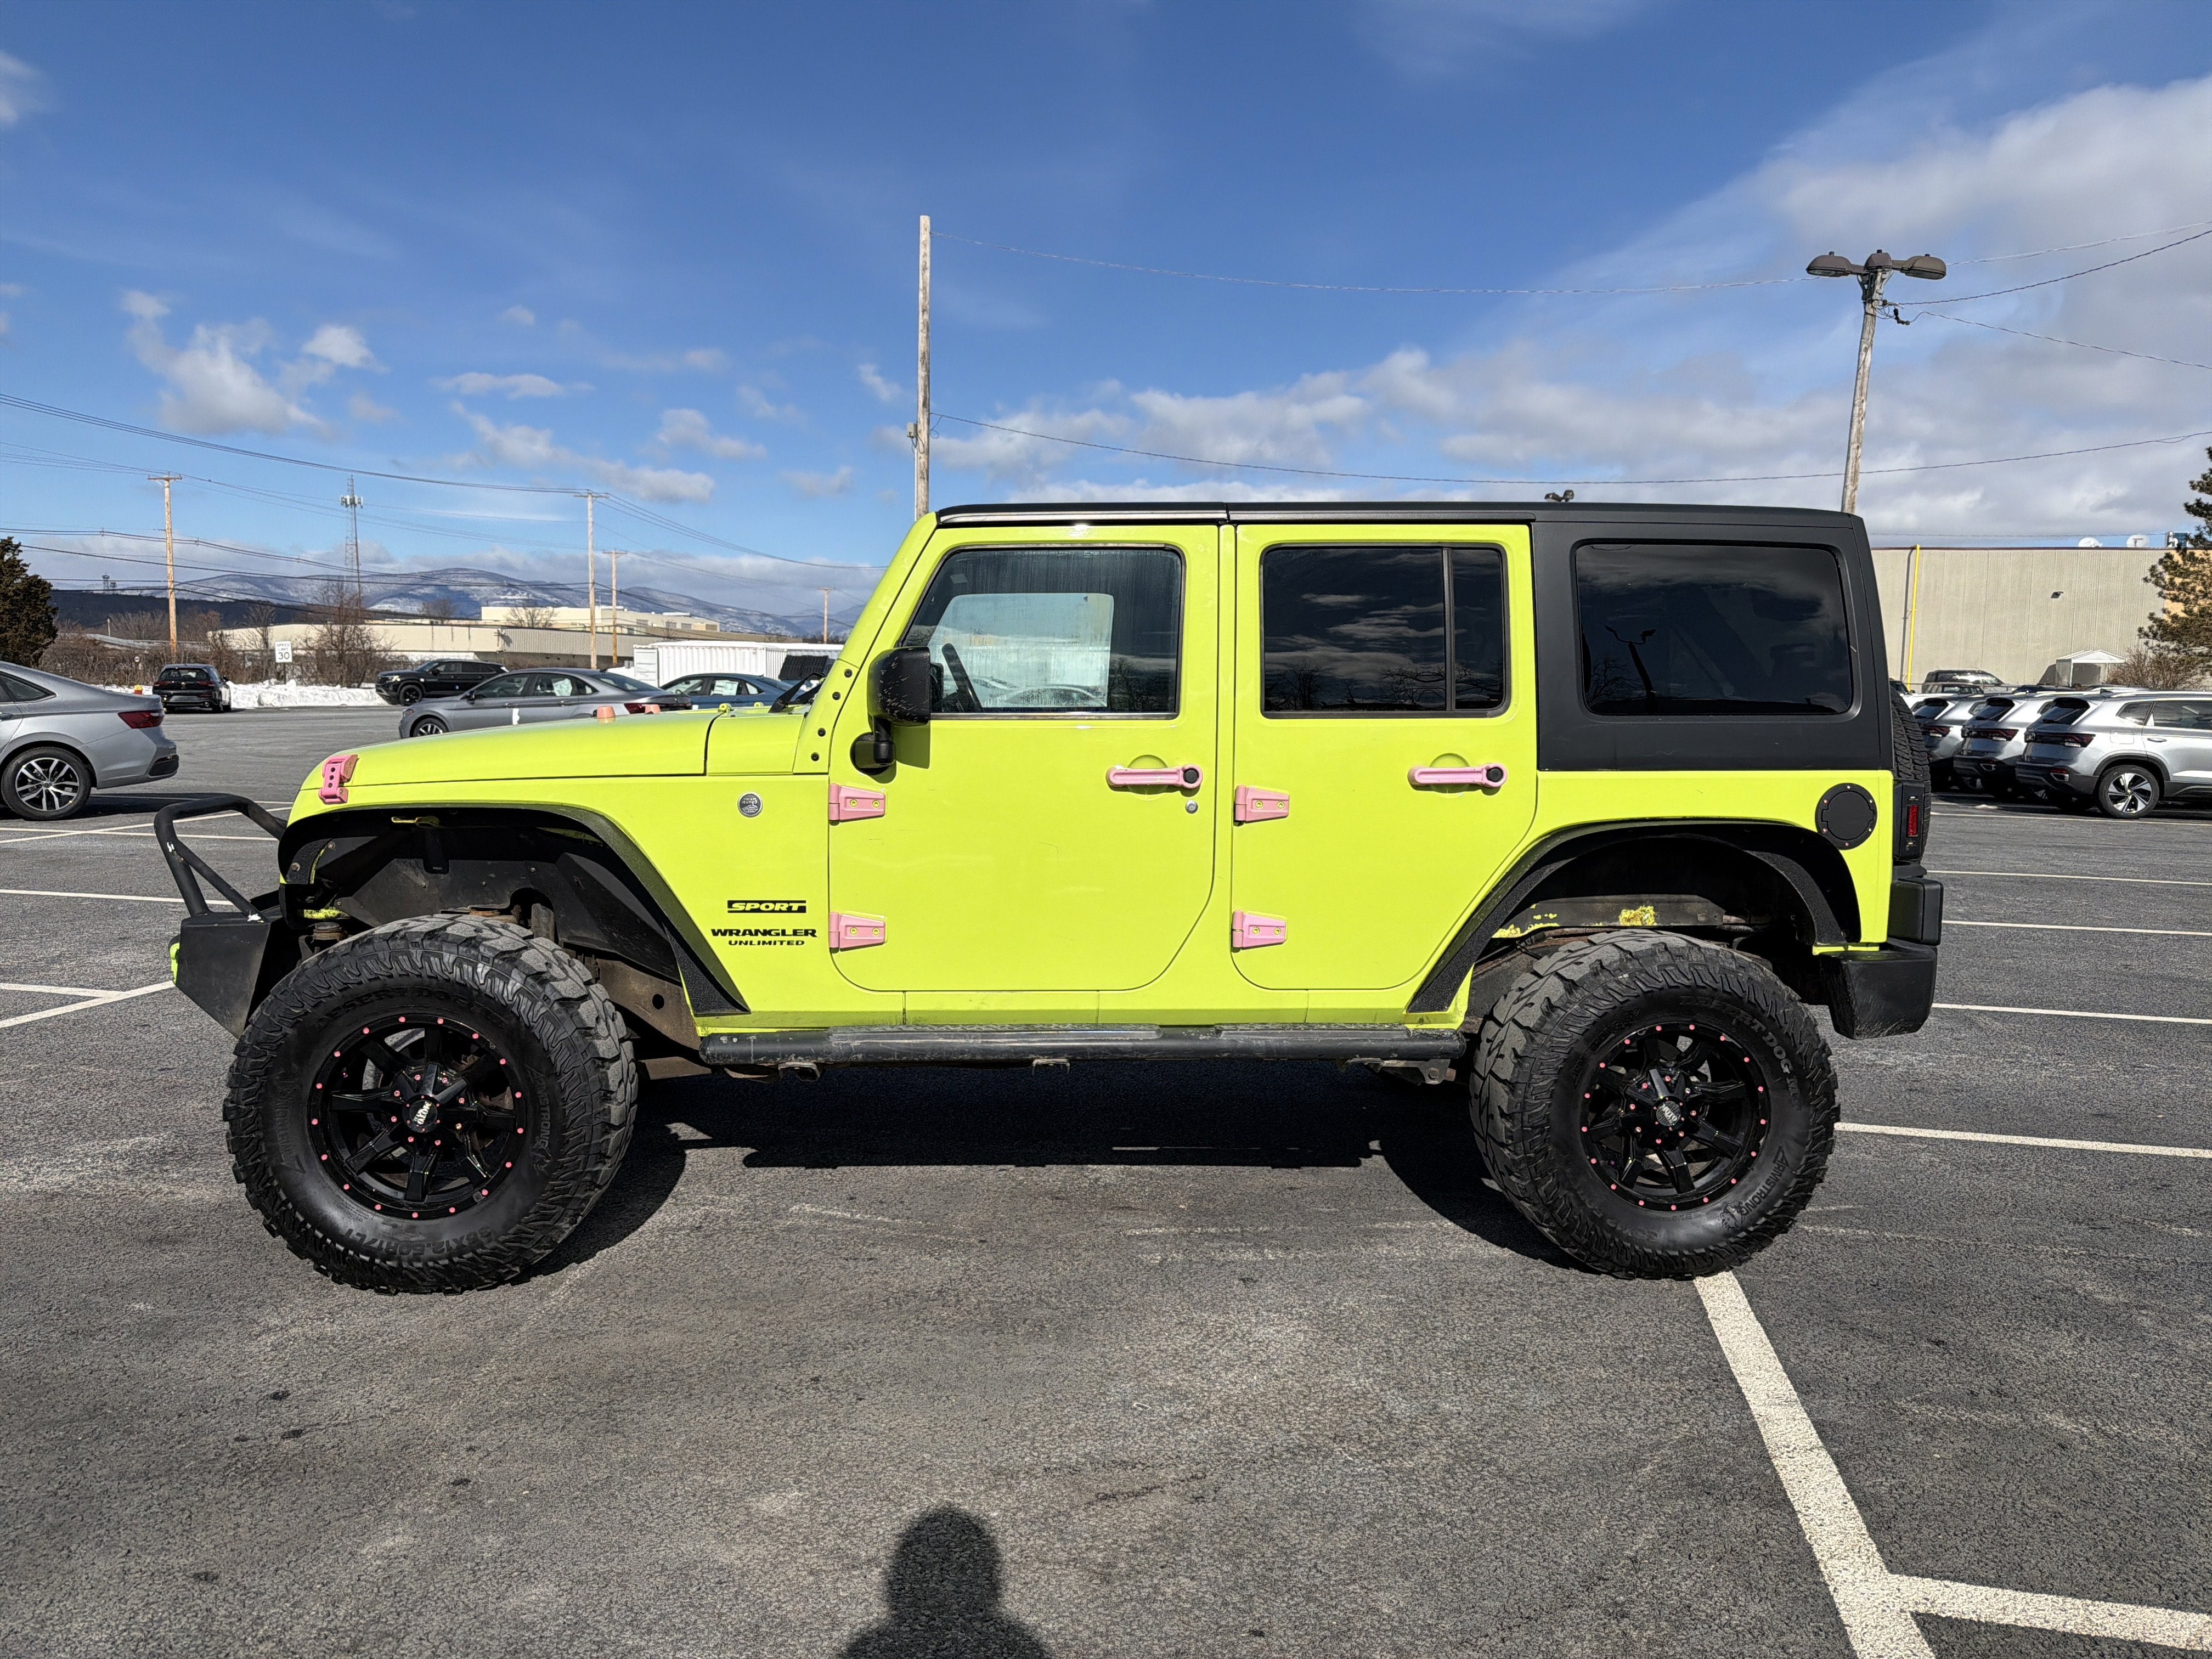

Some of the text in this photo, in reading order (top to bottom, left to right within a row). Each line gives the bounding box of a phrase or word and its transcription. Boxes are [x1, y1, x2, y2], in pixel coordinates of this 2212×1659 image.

[731, 902, 806, 911] SPORT
[711, 929, 817, 937] WRANGLER
[1763, 1032, 1793, 1074] DOG
[417, 1101, 432, 1124] MOTO
[1739, 1146, 1790, 1218] ARMSTRONG
